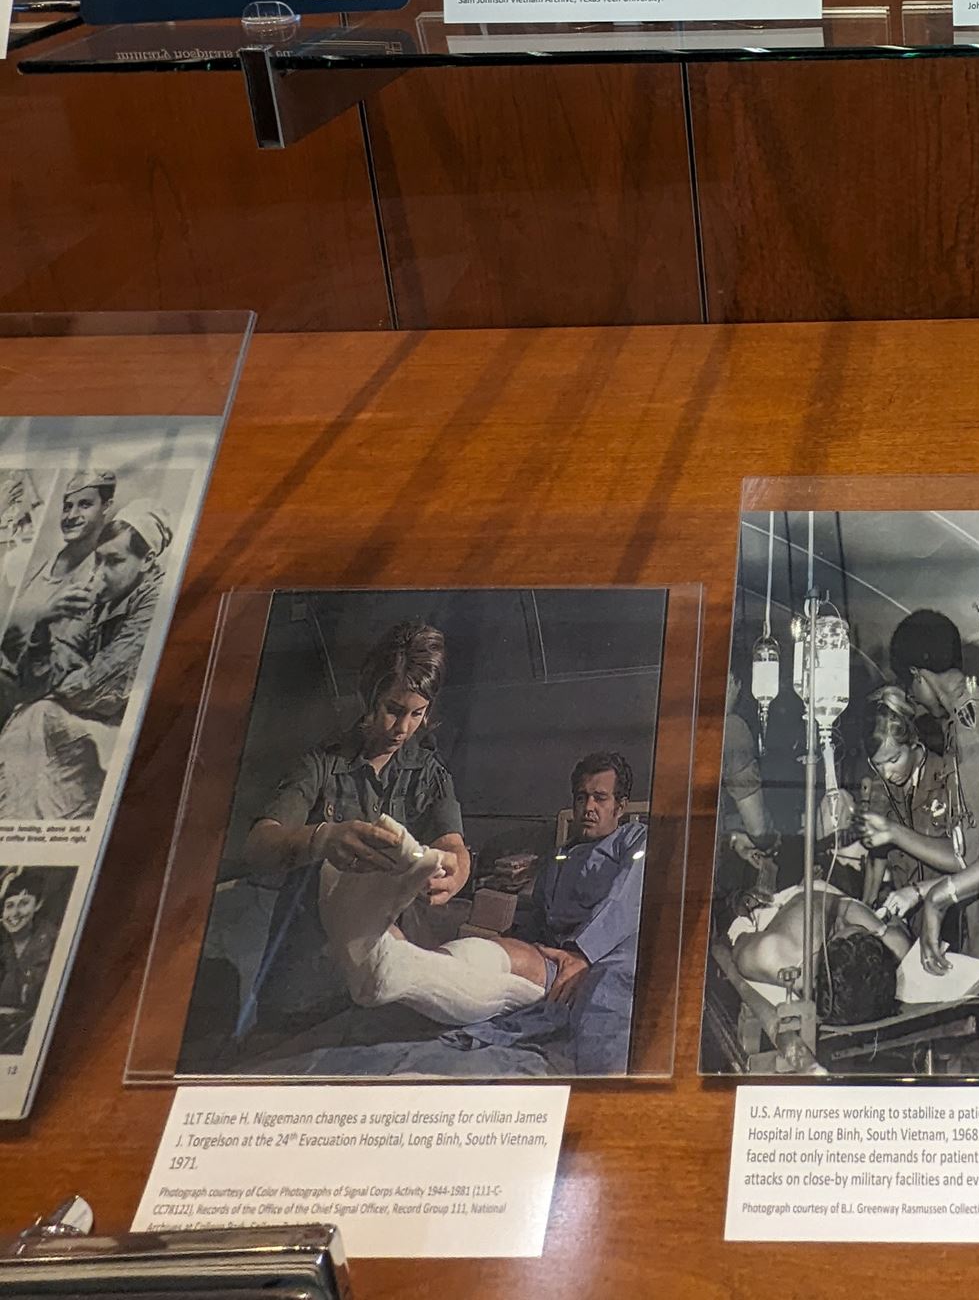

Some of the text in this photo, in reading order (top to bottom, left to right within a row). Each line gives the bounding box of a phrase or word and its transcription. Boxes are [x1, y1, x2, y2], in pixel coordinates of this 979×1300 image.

[187, 1134, 239, 1150] Torgelson
[241, 1135, 253, 1146] at
[255, 1133, 273, 1146] the
[298, 1133, 357, 1146] Evacuation
[359, 1133, 404, 1148] Hospital,
[408, 1133, 433, 1148] Long
[435, 1132, 462, 1147] Binh,
[465, 1132, 497, 1146] South
[500, 1132, 547, 1147] Vietnam,
[744, 1172, 782, 1185] attacks
[786, 1175, 800, 1185] on
[803, 1171, 848, 1188] close-by
[851, 1171, 892, 1188] military
[895, 1171, 940, 1186] facilities
[943, 1172, 963, 1186] and
